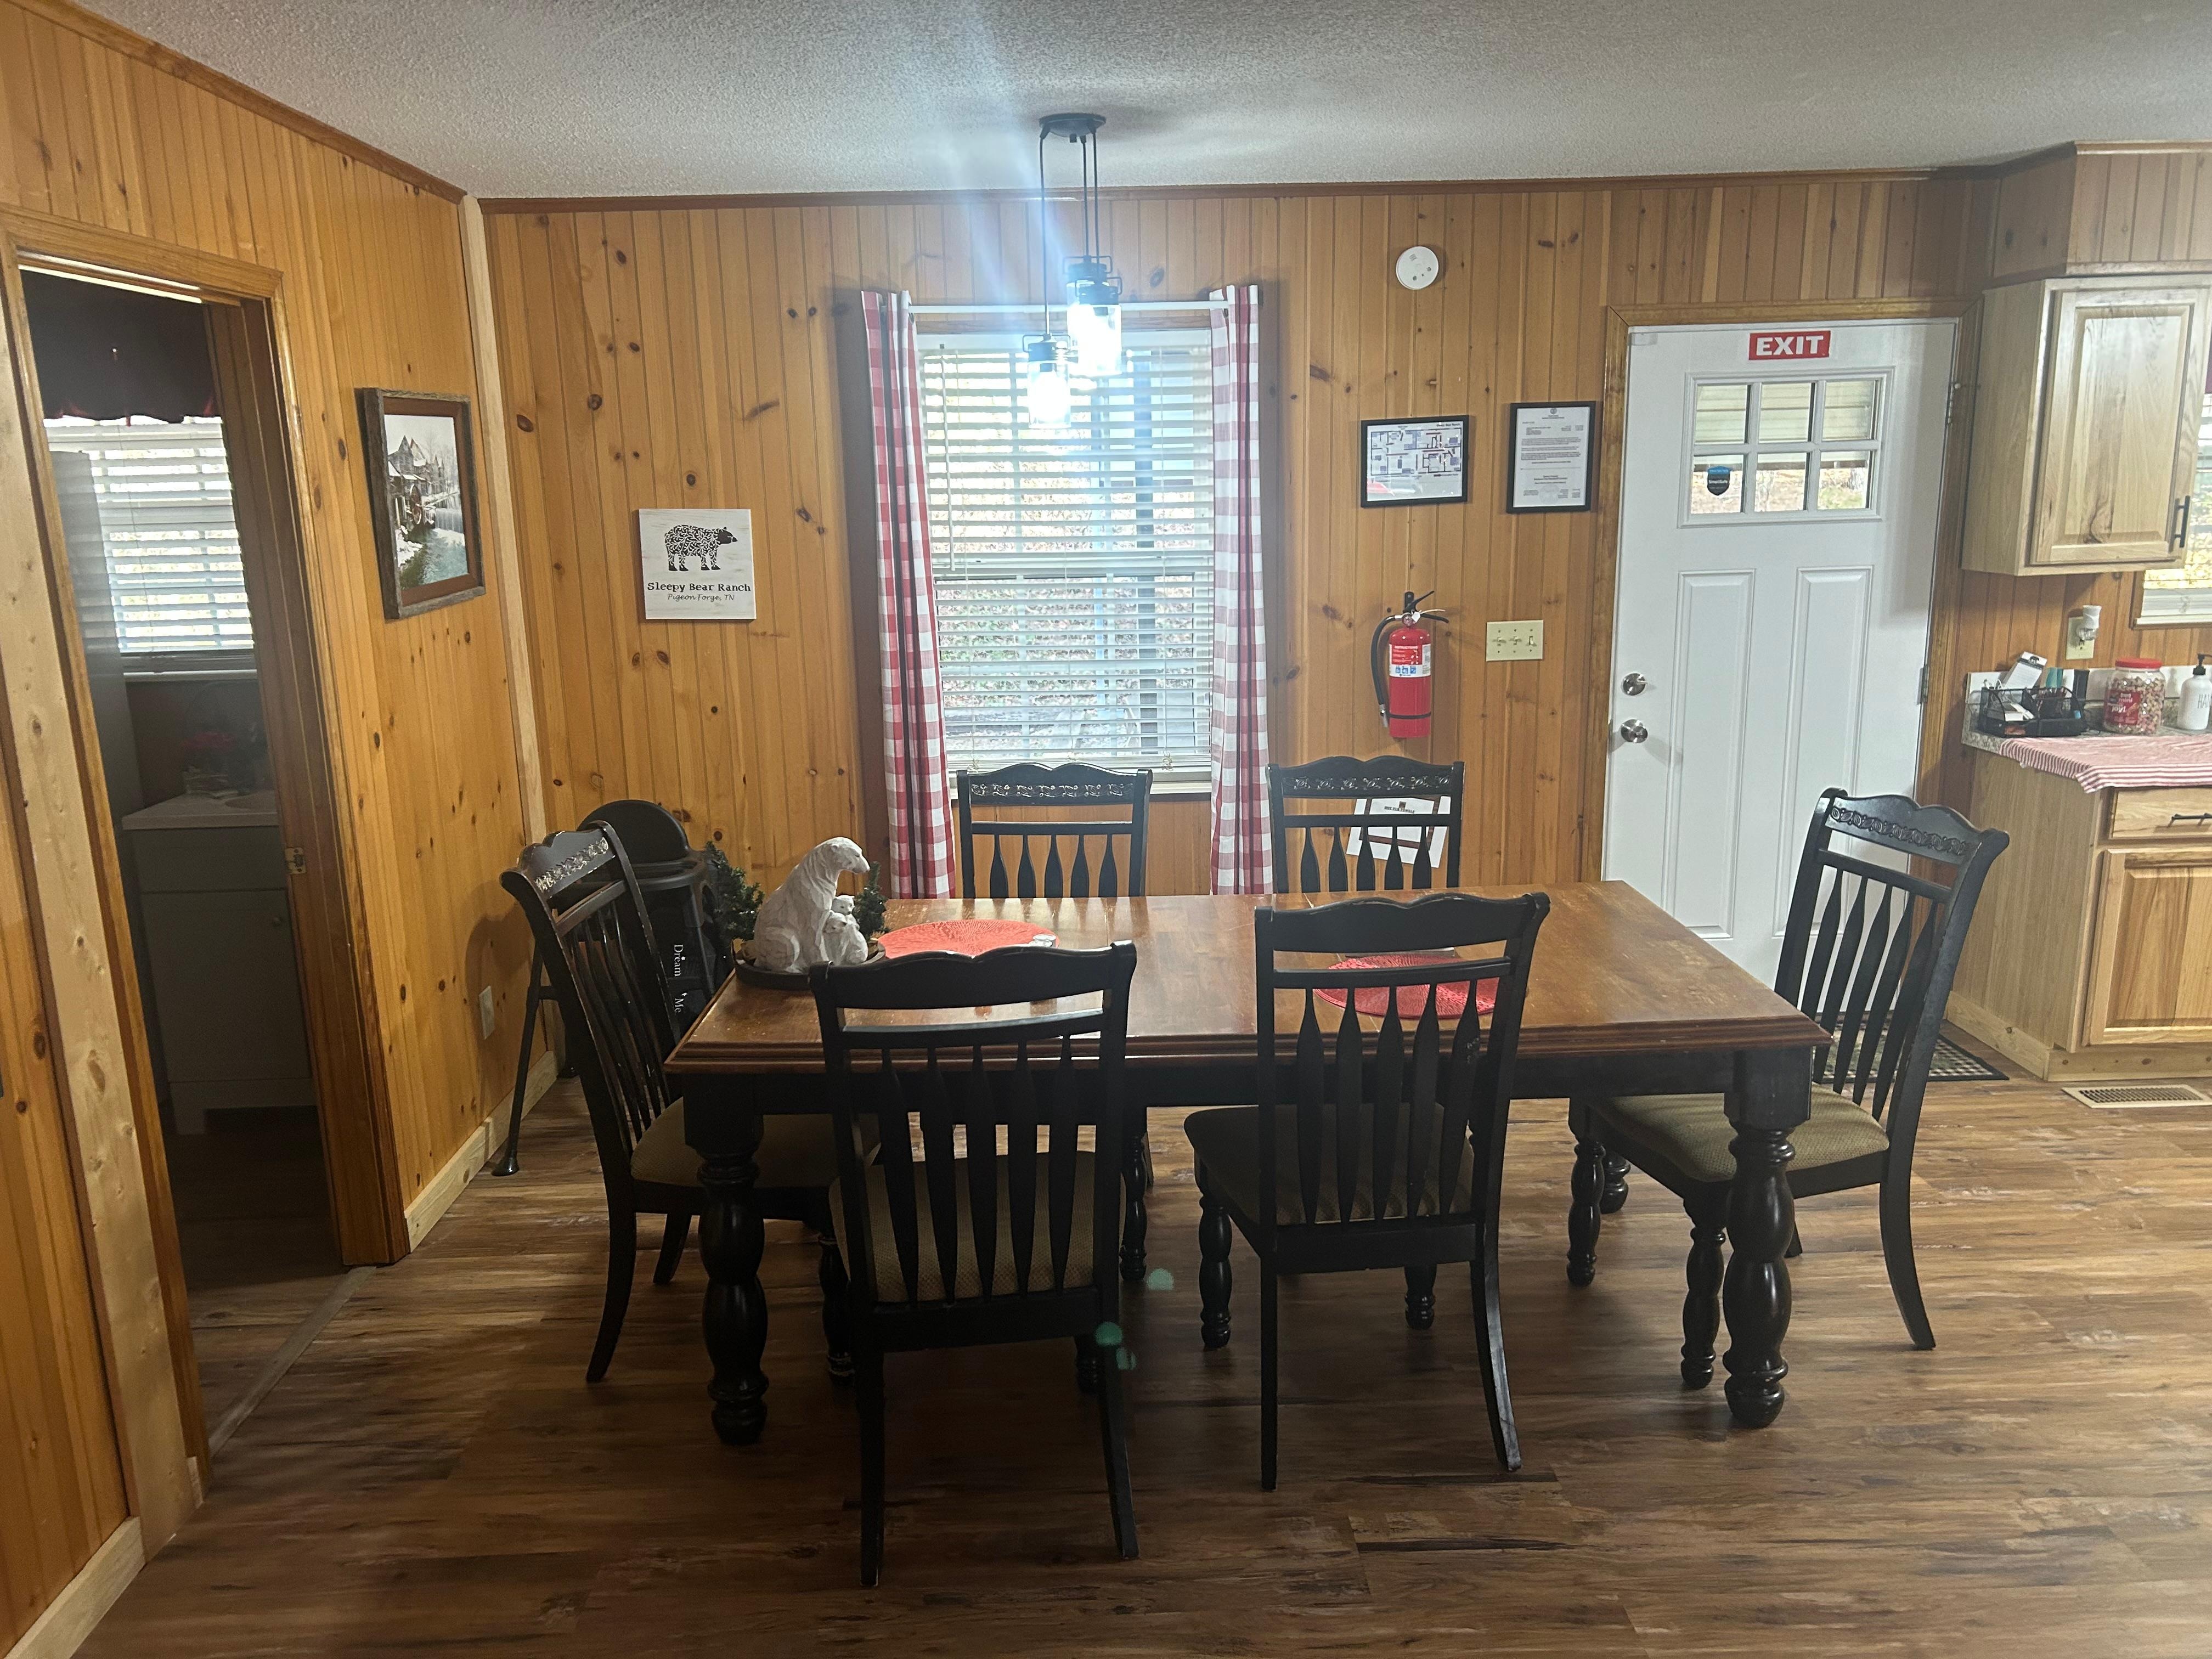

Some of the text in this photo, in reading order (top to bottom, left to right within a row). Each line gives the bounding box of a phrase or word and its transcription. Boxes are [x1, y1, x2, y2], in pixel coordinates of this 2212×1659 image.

[1756, 335, 1824, 356] EXIT
[647, 582, 686, 592] Sleepy
[718, 583, 751, 591] Ranch
[668, 594, 697, 602] Pigeon
[697, 594, 723, 602] Forge,
[674, 944, 684, 1013] Dream Me
